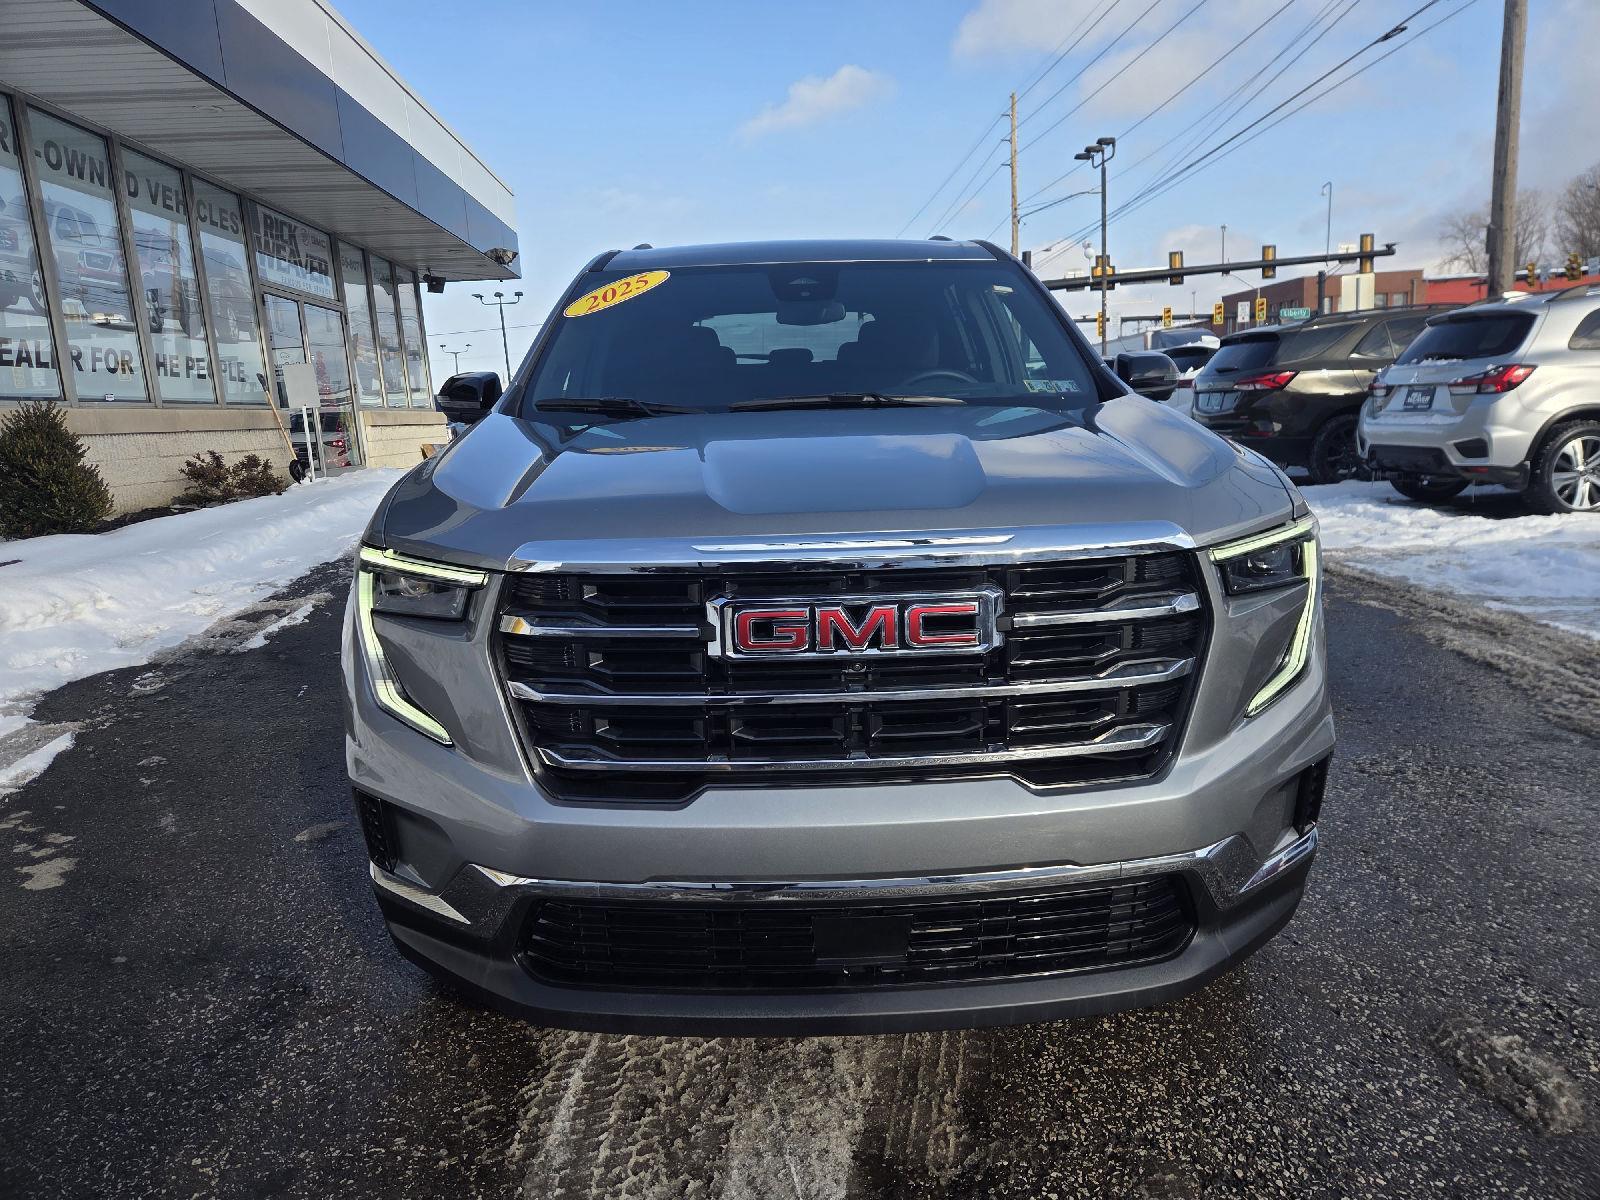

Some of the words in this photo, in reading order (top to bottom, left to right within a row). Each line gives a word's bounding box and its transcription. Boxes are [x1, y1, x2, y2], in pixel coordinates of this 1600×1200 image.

[146, 178, 240, 235] VEHCLES
[263, 212, 298, 247] RICK
[586, 275, 649, 312] 2025
[1284, 309, 1307, 317] Liberty
[0, 337, 84, 372] EALR
[91, 347, 134, 374] FOR
[156, 353, 180, 378] HE
[735, 603, 982, 652] GMC
